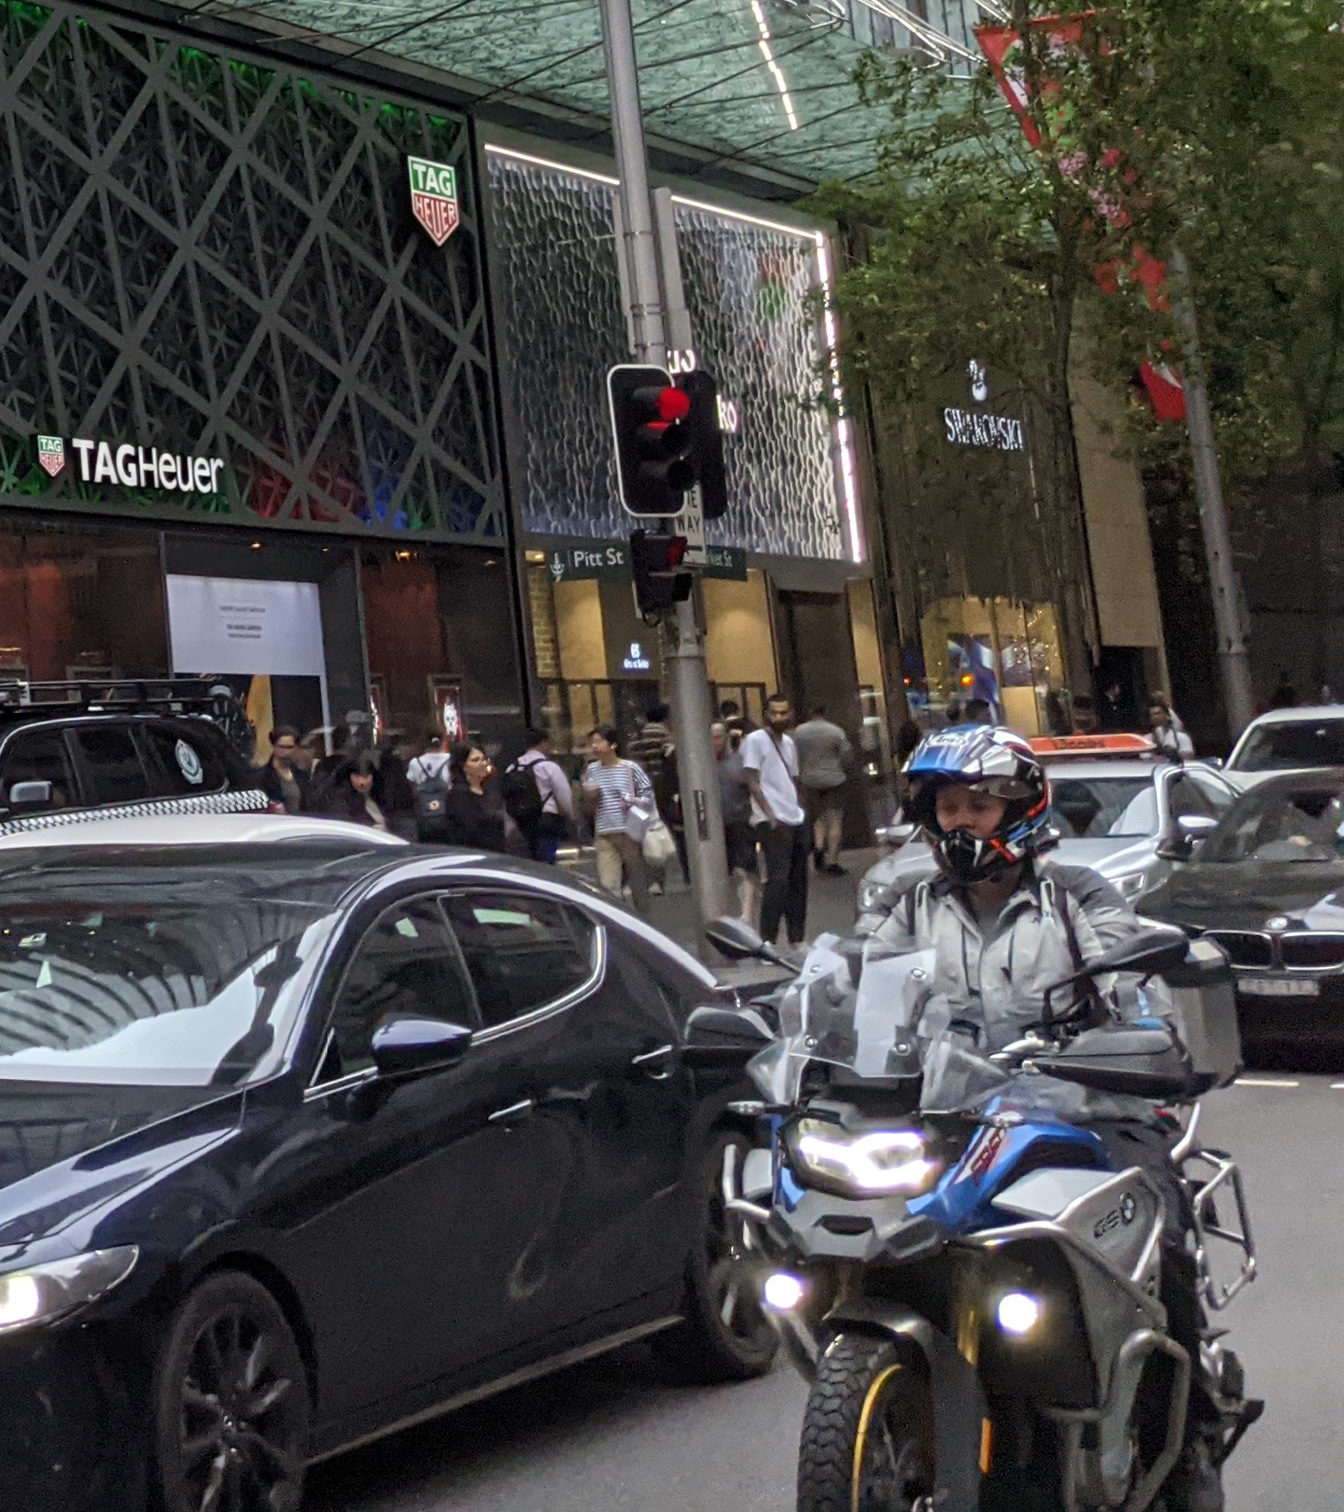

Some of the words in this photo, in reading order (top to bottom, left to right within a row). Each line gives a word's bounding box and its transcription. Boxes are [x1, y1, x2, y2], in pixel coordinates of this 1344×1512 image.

[412, 163, 452, 197] TAG
[414, 196, 456, 239] HEUER
[40, 438, 62, 452] TAG
[72, 438, 225, 494] TAGHeuer
[573, 550, 603, 568] Pitt
[606, 547, 624, 566] St
